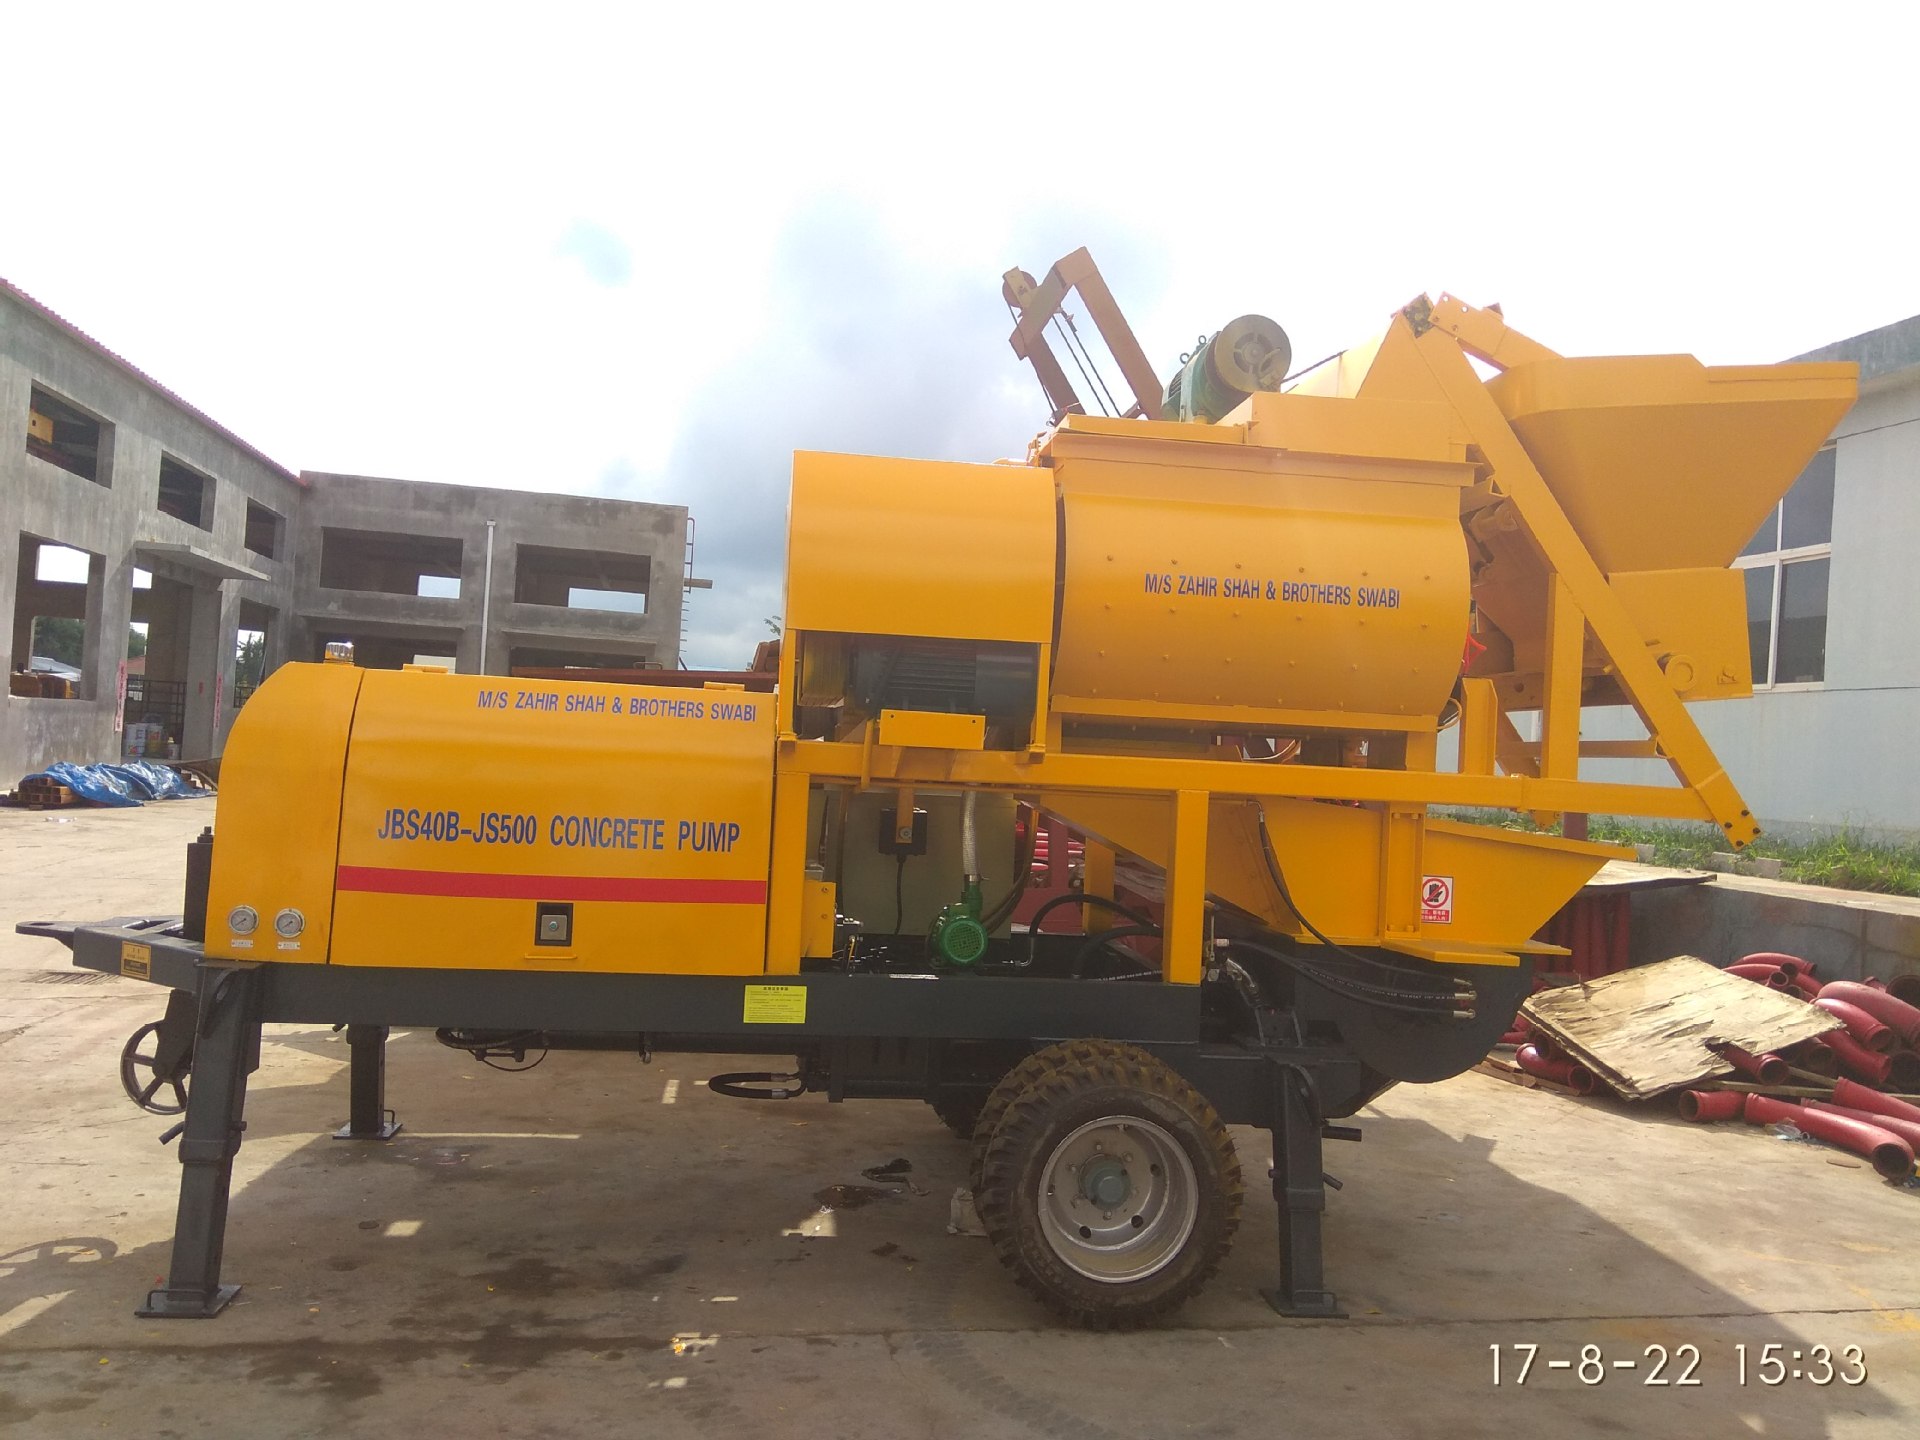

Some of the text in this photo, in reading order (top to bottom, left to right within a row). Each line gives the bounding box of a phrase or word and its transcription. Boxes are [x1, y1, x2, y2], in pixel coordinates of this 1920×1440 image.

[1145, 573, 1400, 609] M/S ZAHIR SHAH & BROTHERS SWABI
[477, 690, 758, 723] M/S ZAHIR SHAH & BROTHERS SWABI
[377, 809, 740, 853] JBS40B-JS500 CONCRETE PUMP
